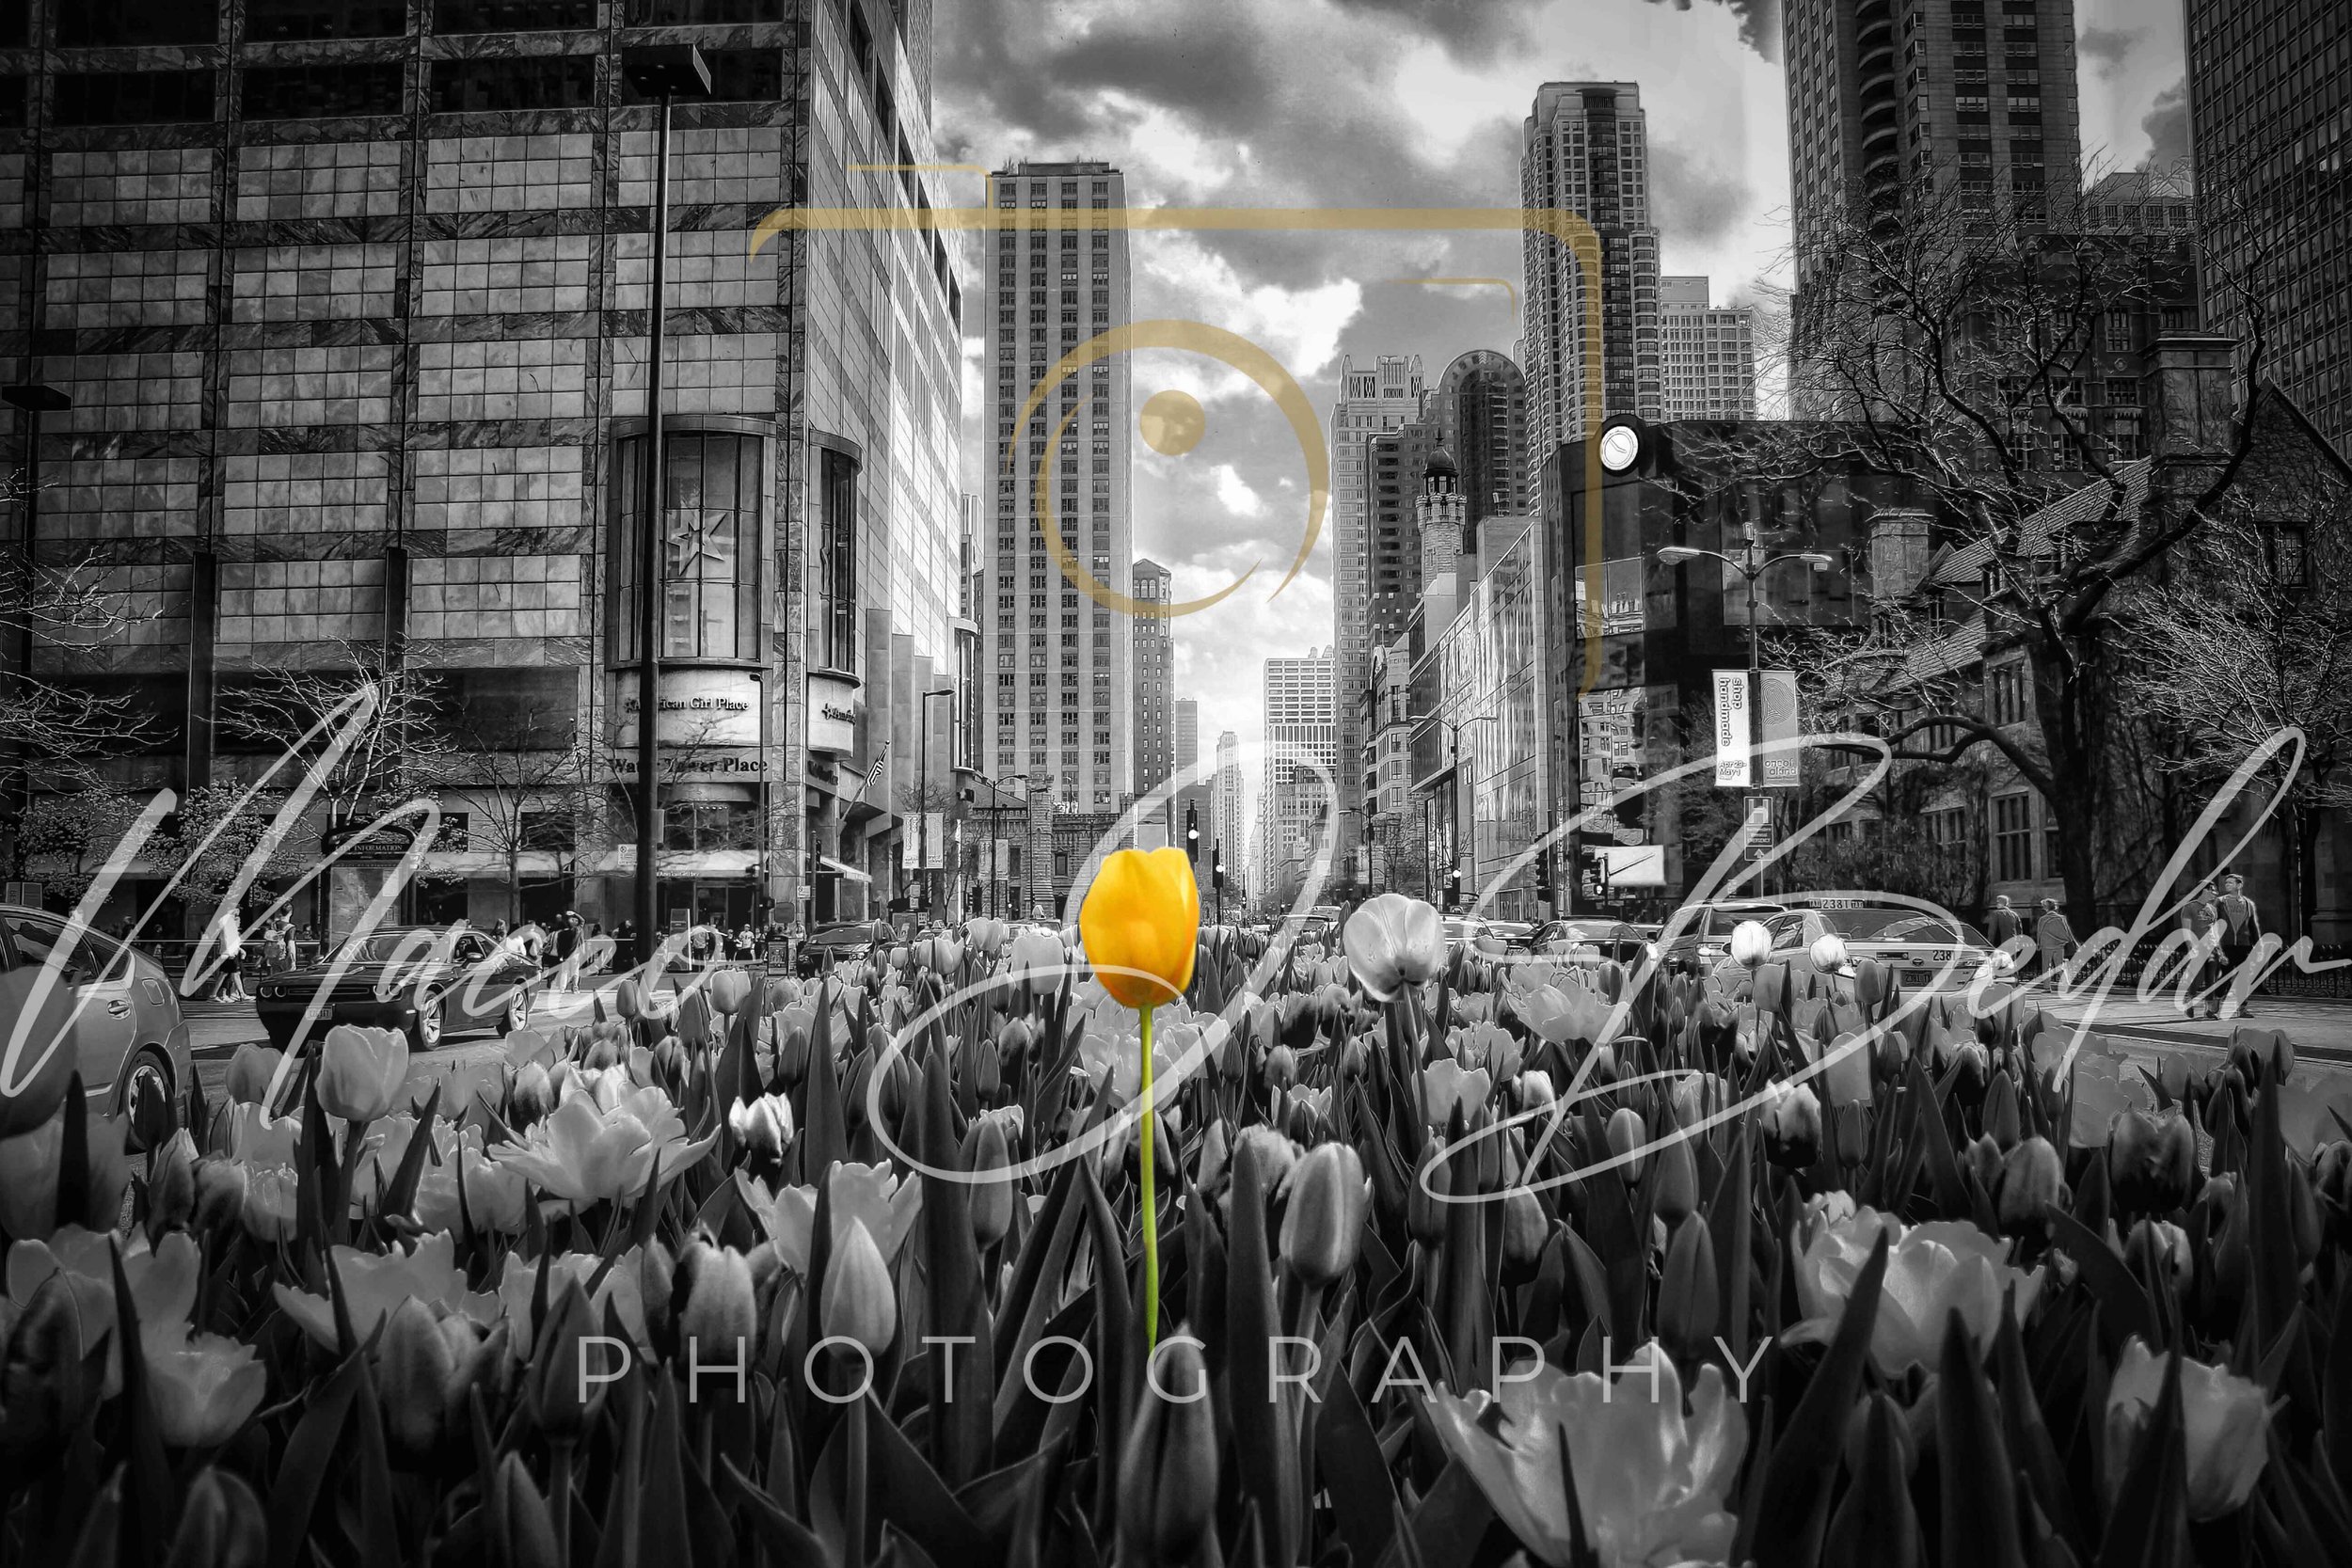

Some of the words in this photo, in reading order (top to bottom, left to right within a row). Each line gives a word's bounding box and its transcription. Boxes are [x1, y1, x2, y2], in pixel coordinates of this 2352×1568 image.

[691, 697, 713, 709] Girl
[717, 697, 750, 711] Place
[1732, 677, 1744, 709] shop
[1719, 677, 1732, 747] handmade
[723, 757, 768, 772] Place
